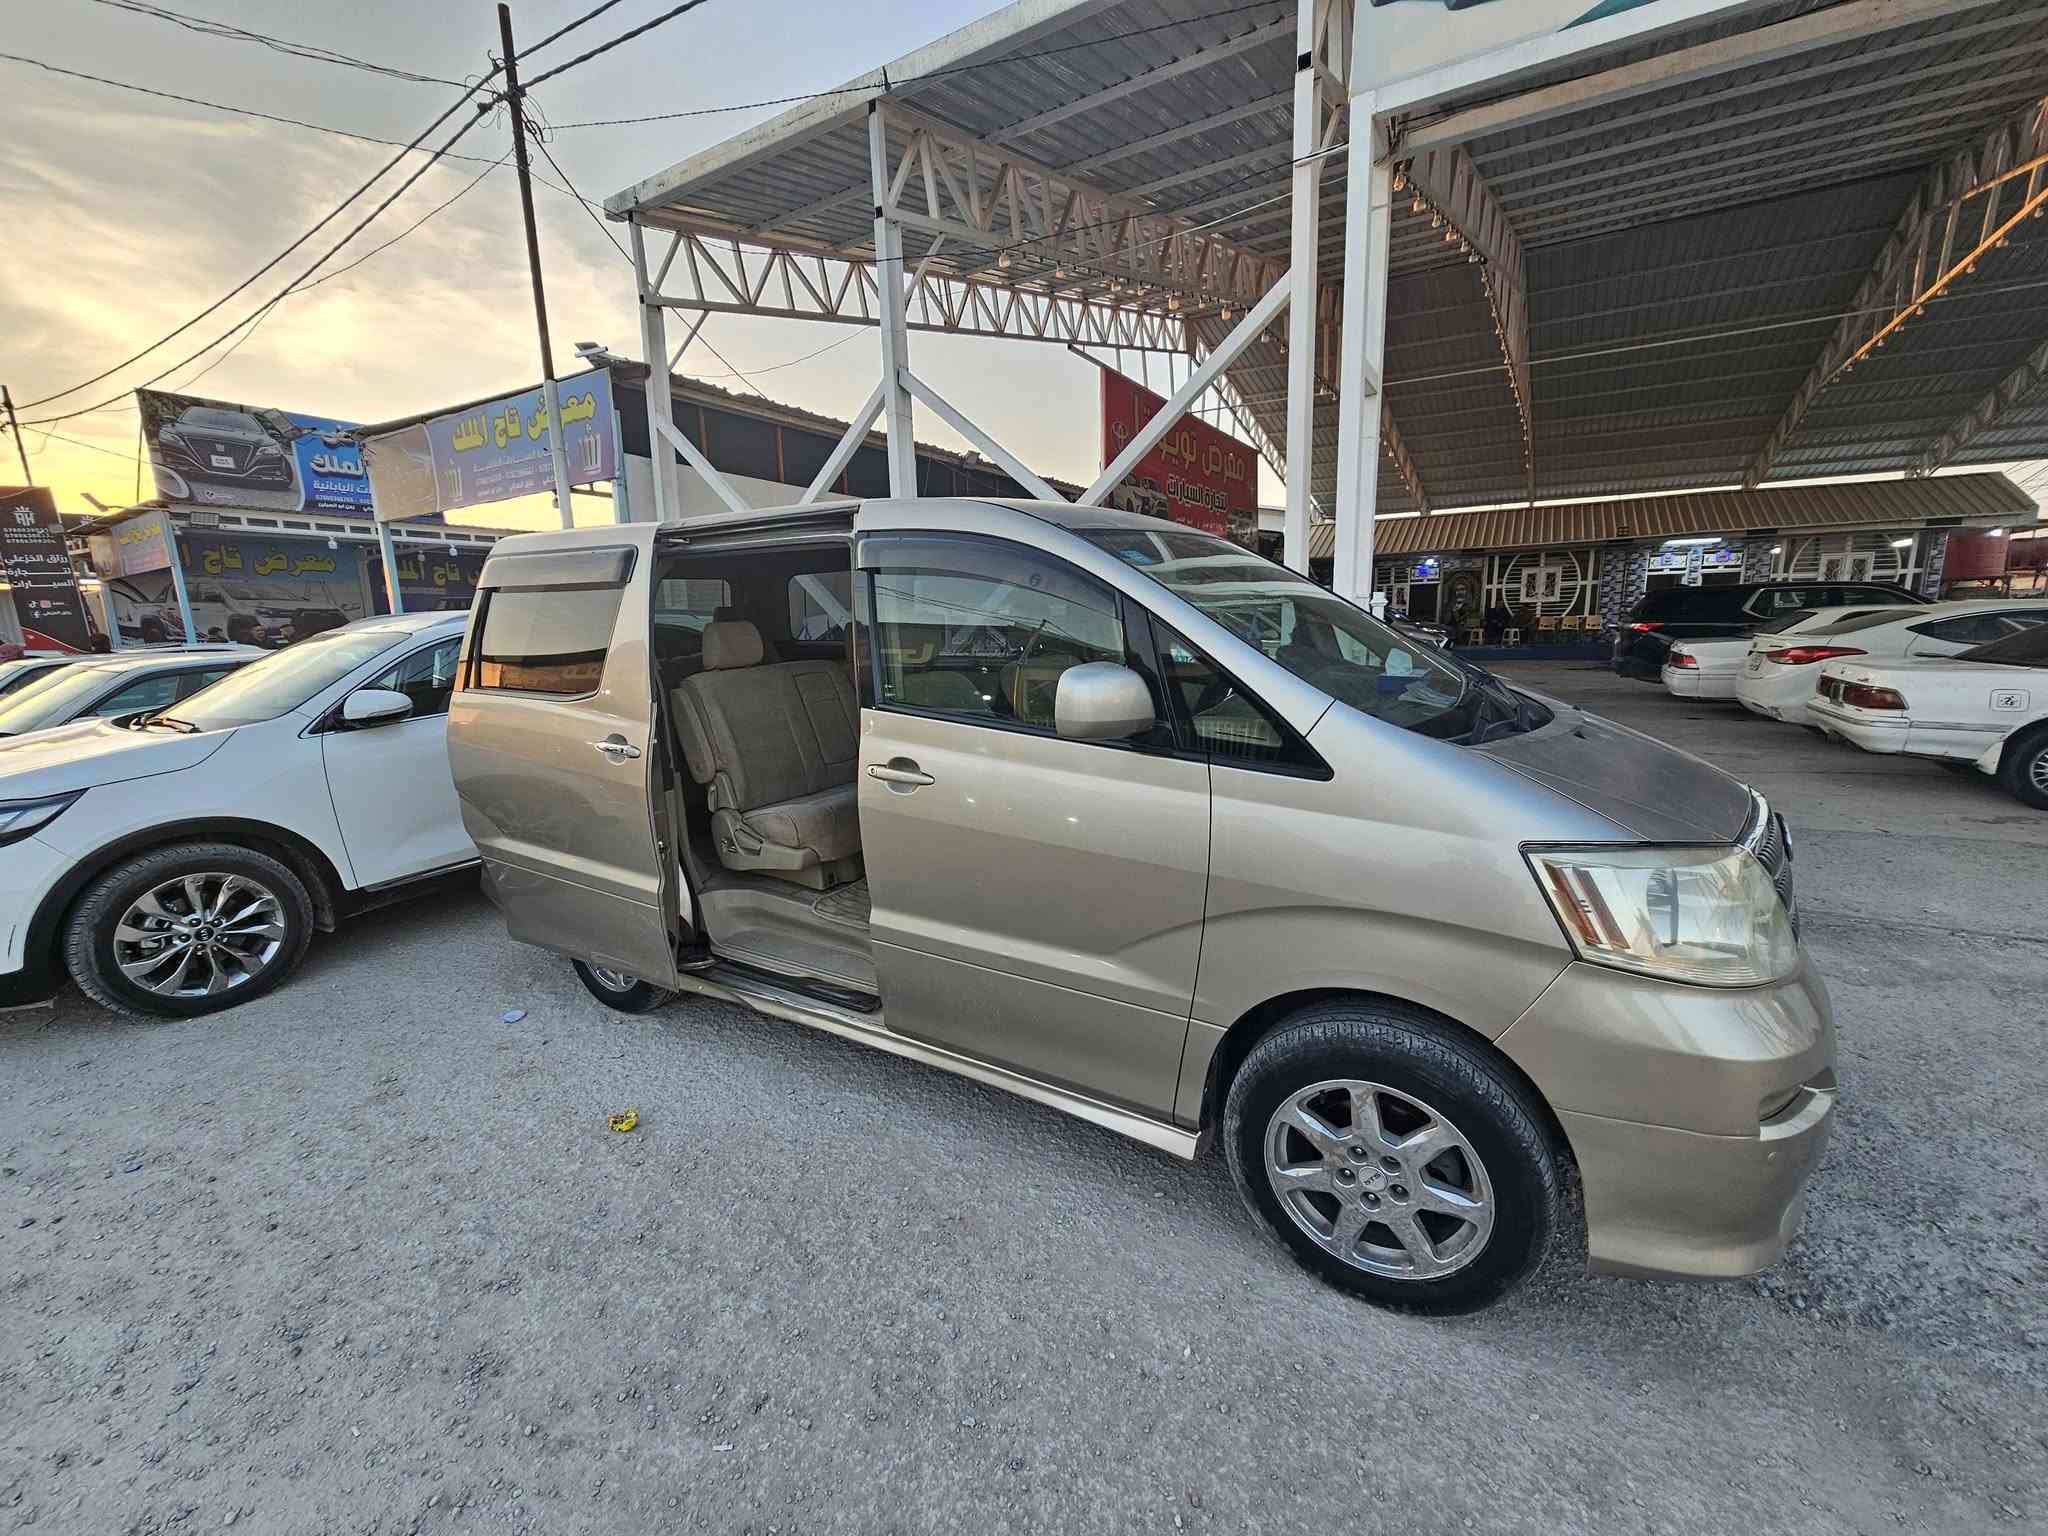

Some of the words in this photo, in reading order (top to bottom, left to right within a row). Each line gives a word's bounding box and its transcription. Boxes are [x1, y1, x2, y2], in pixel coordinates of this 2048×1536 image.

[453, 414, 489, 451] الله
[495, 406, 521, 449] تاج
[1202, 440, 1247, 483] معرض
[313, 480, 354, 495] اليابانية
[1168, 473, 1204, 508] السيارات
[1204, 486, 1230, 513] لتجارة
[200, 543, 243, 577] تاج
[253, 545, 337, 577] معرض
